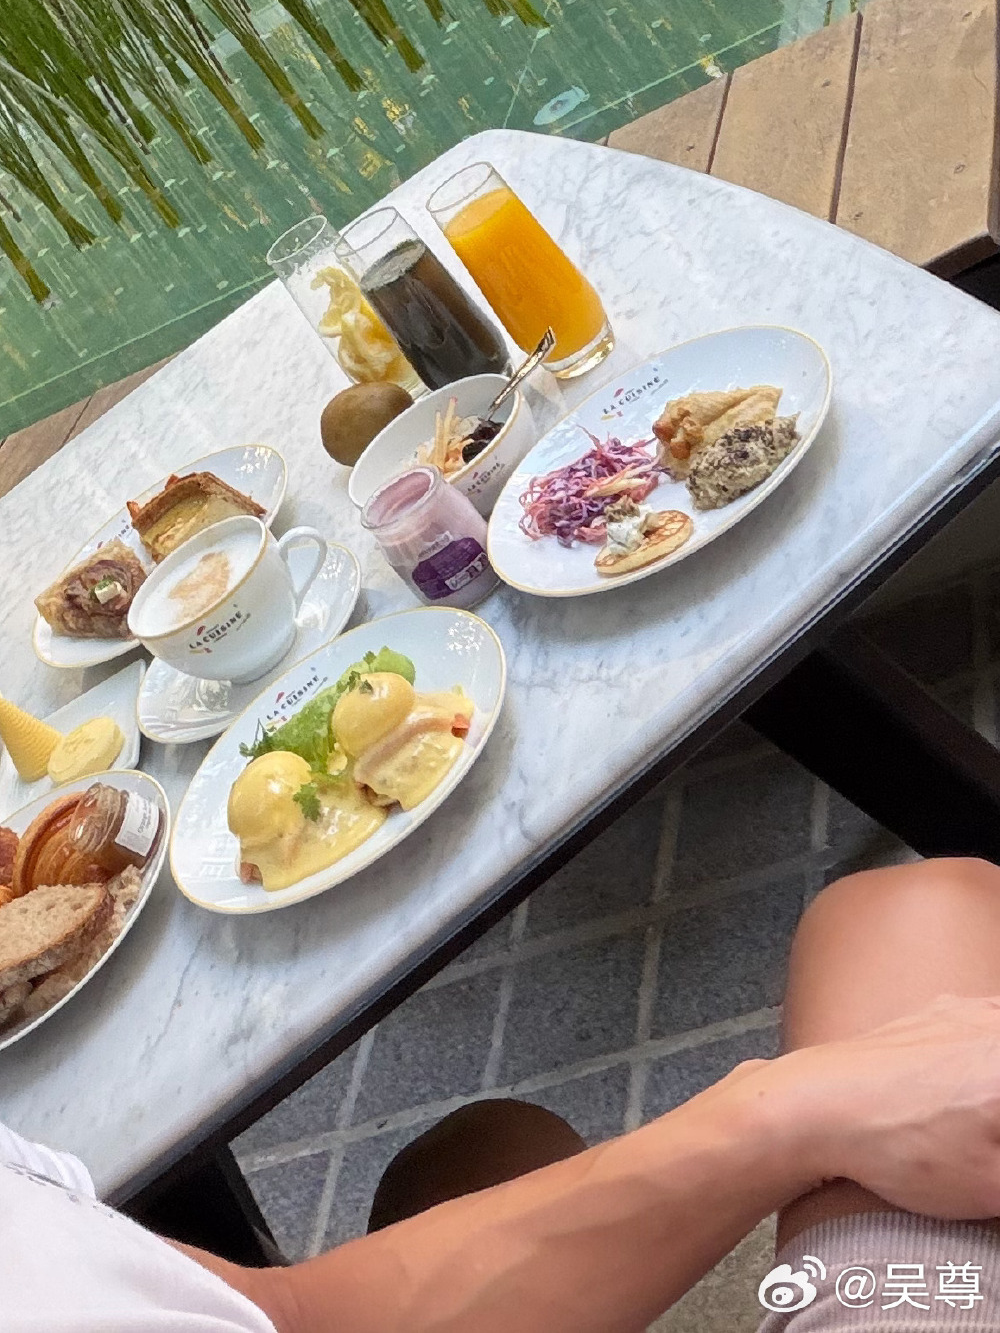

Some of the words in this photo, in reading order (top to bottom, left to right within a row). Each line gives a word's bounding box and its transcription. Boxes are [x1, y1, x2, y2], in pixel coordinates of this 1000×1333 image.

[189, 639, 203, 649] LA
[202, 611, 243, 643] CUISINE
[267, 710, 279, 720] LA
[280, 675, 320, 710] CUISINE
